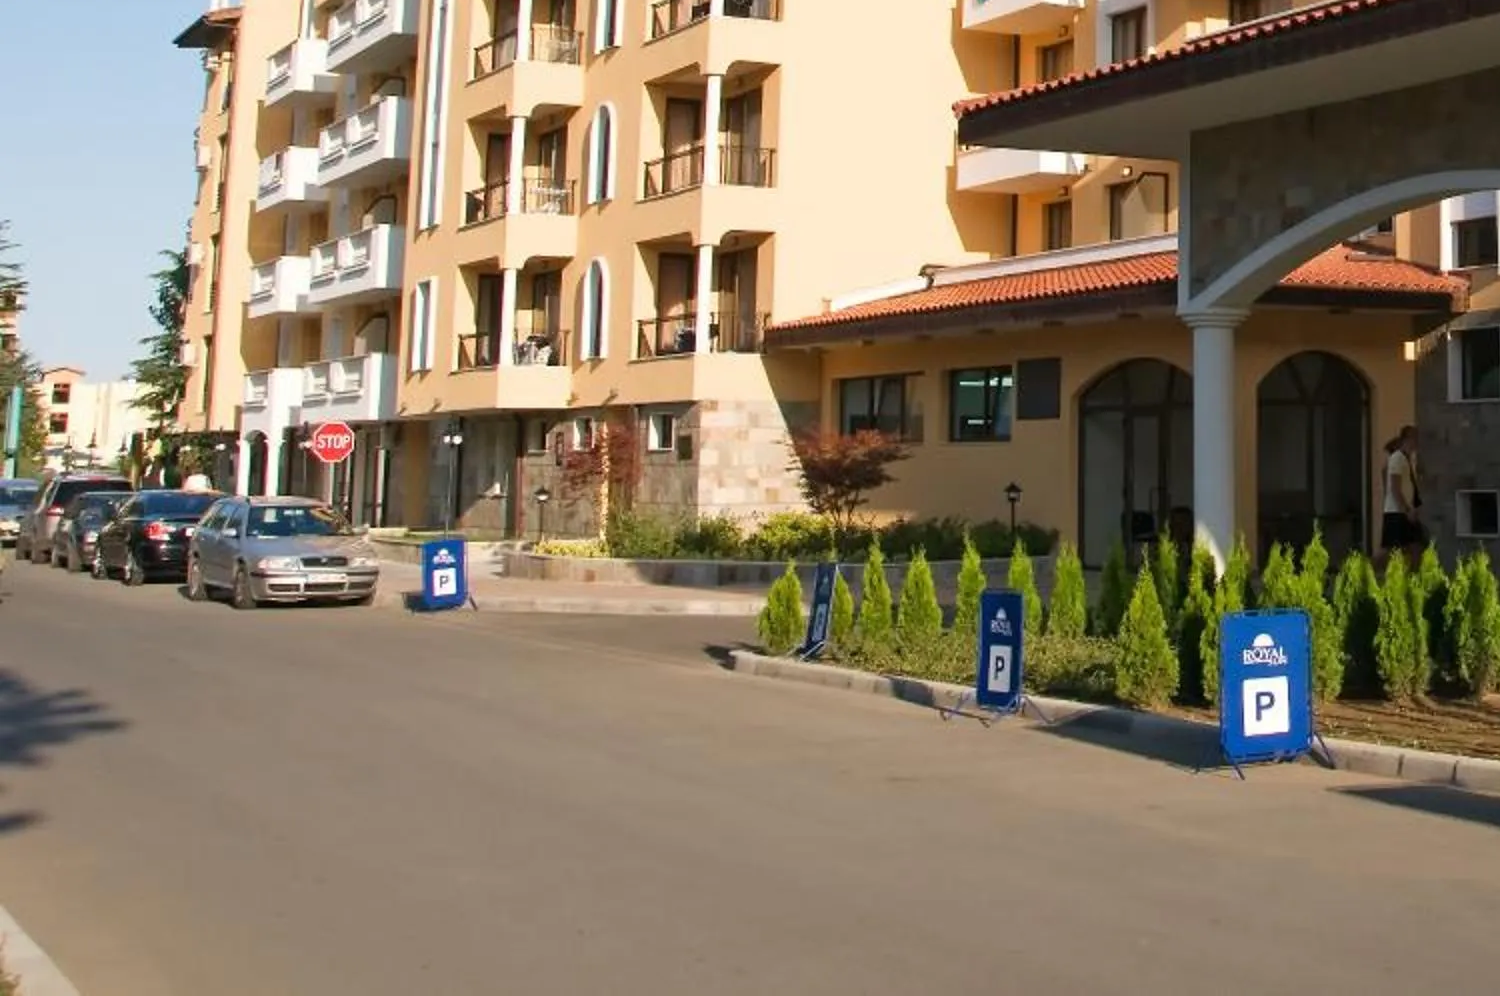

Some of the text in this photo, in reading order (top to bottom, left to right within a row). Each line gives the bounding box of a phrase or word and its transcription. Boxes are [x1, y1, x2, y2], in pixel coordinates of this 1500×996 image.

[317, 434, 350, 449] STOP
[440, 575, 449, 588] P
[1243, 644, 1287, 659] ROYAL
[994, 655, 1004, 680] P
[1255, 691, 1275, 722] P
